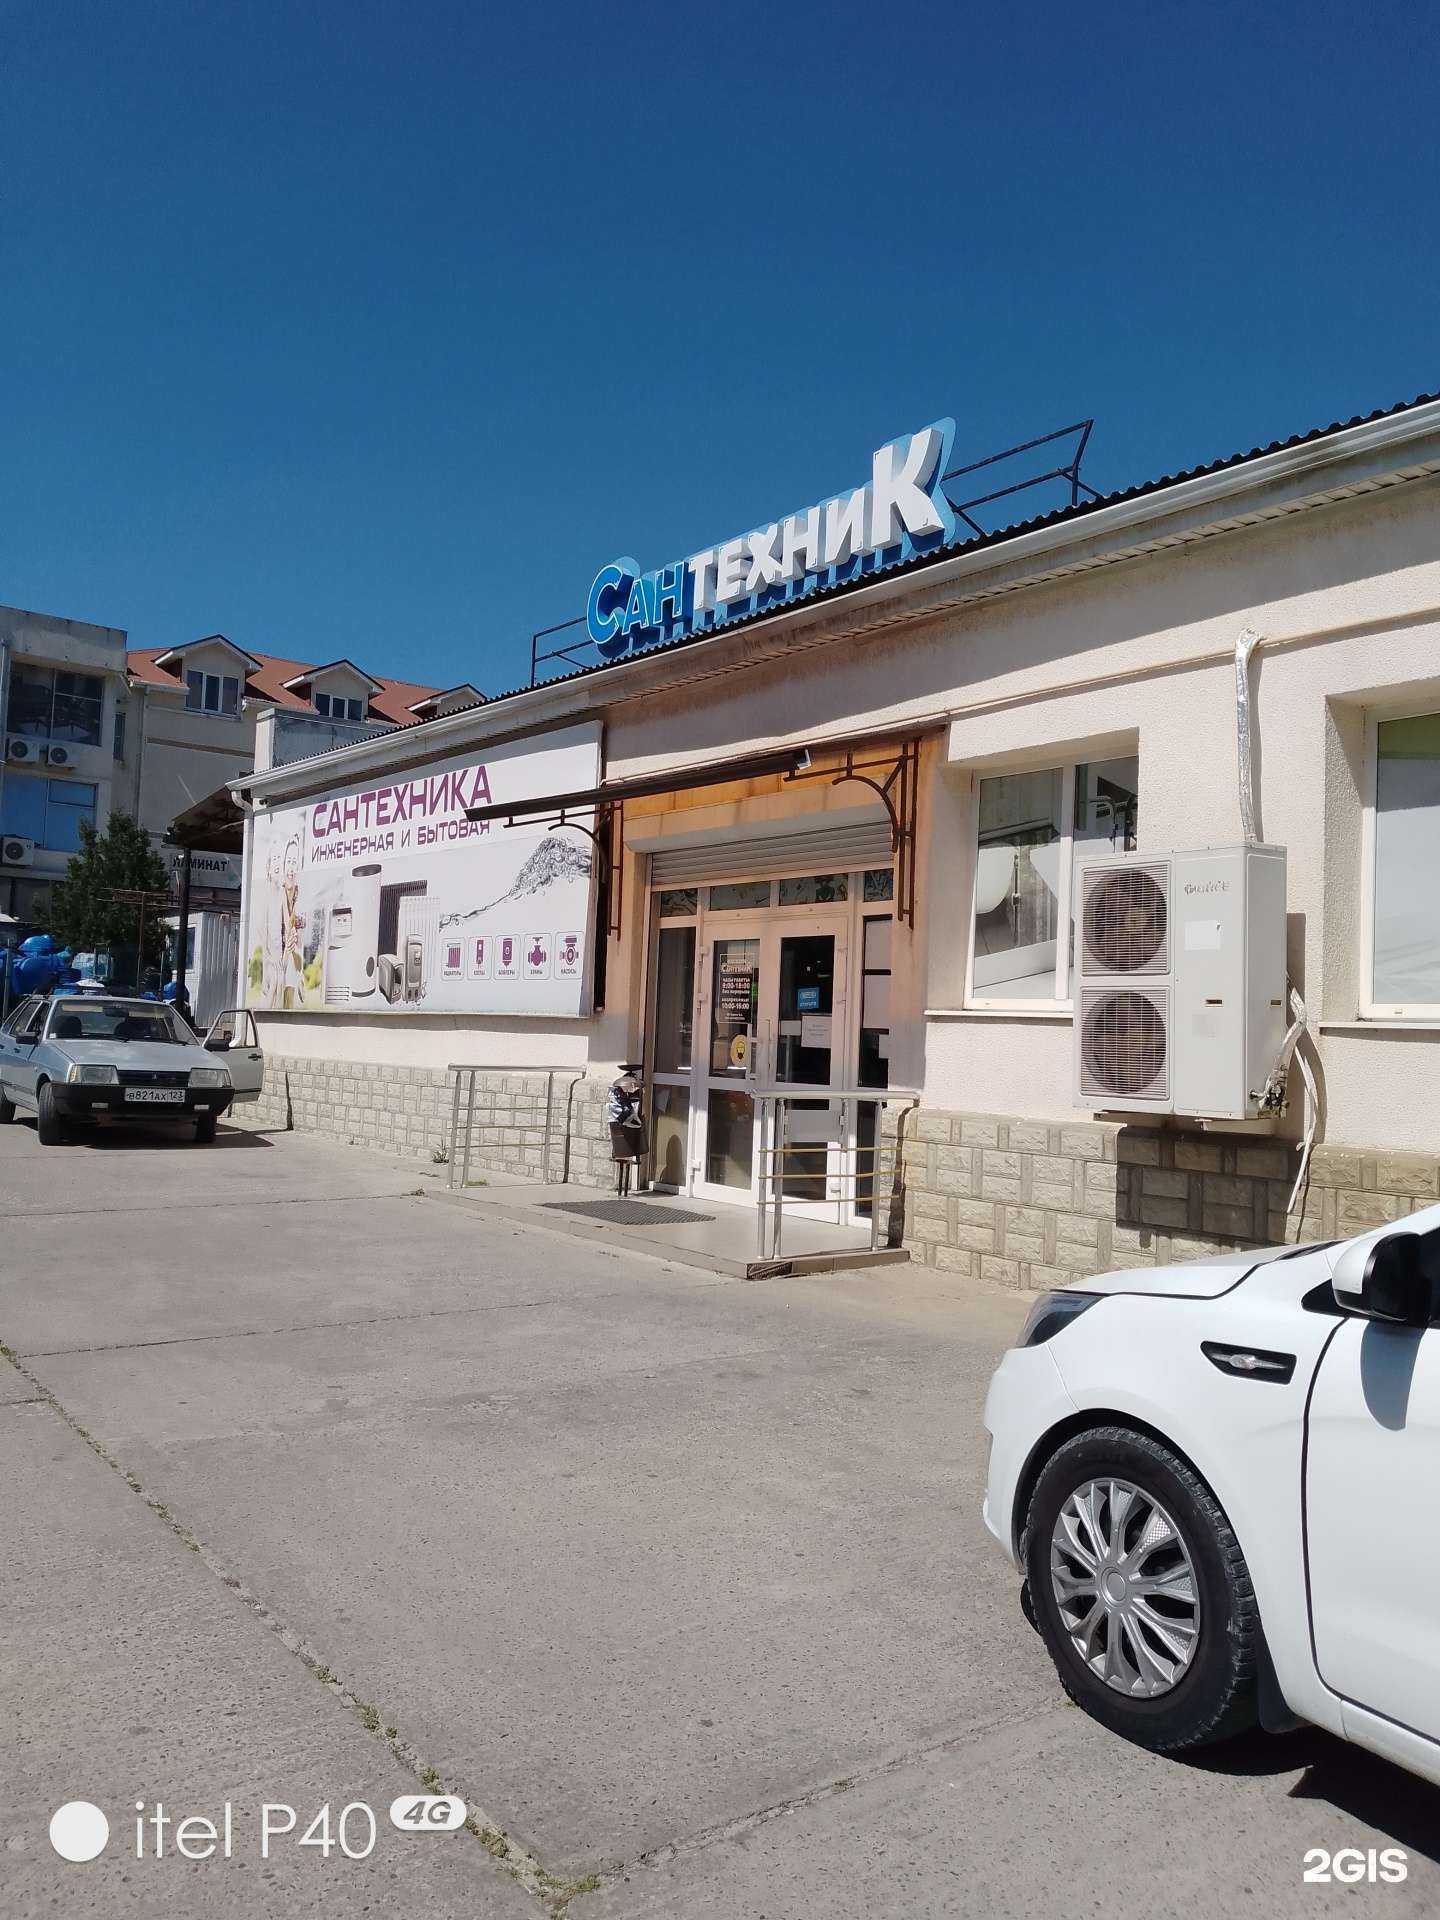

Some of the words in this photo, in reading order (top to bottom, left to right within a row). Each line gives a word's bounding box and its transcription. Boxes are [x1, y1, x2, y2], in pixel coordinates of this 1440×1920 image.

[312, 765, 492, 838] САНТЕХНИКА
[312, 831, 394, 863] ИНЖЕНЕРНАЯ
[401, 829, 411, 848] И
[417, 818, 490, 845] БЫТОВАЯ
